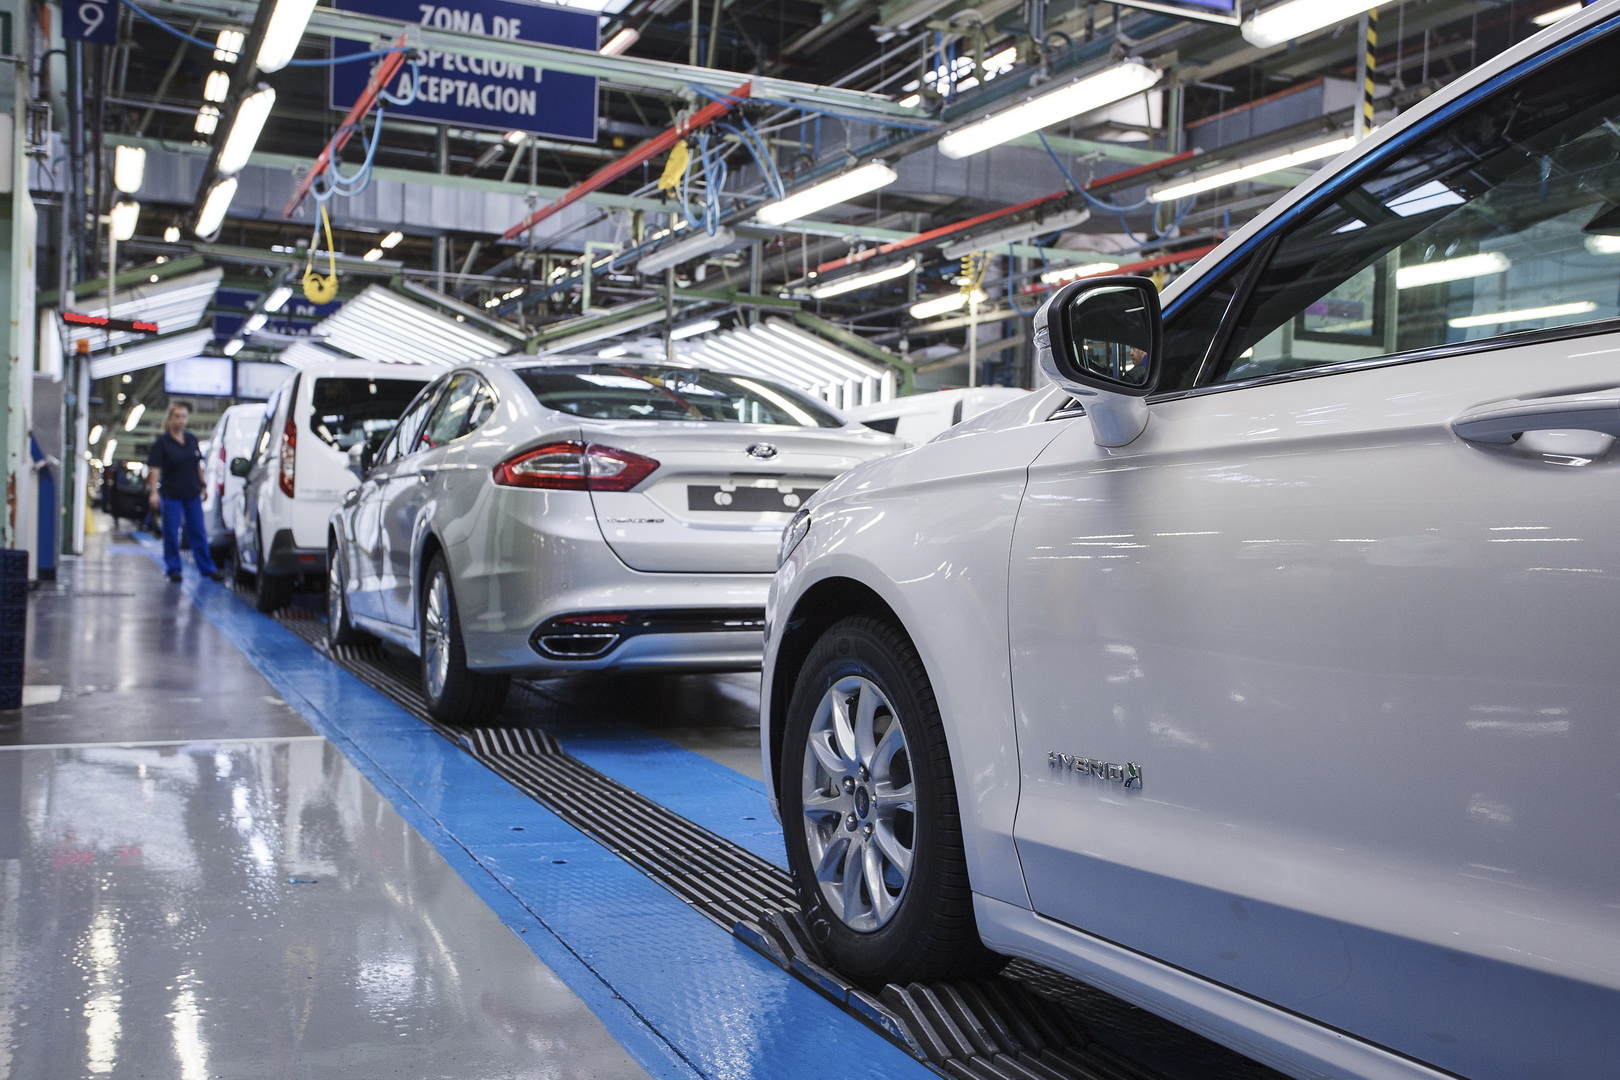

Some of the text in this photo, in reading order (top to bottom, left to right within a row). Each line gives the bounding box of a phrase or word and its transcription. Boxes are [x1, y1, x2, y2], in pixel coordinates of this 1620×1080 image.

[79, 2, 104, 37] 9
[419, 4, 521, 40] ZONA DE
[396, 71, 537, 116] ACEPTACION
[1047, 750, 1124, 783] HYBRID
